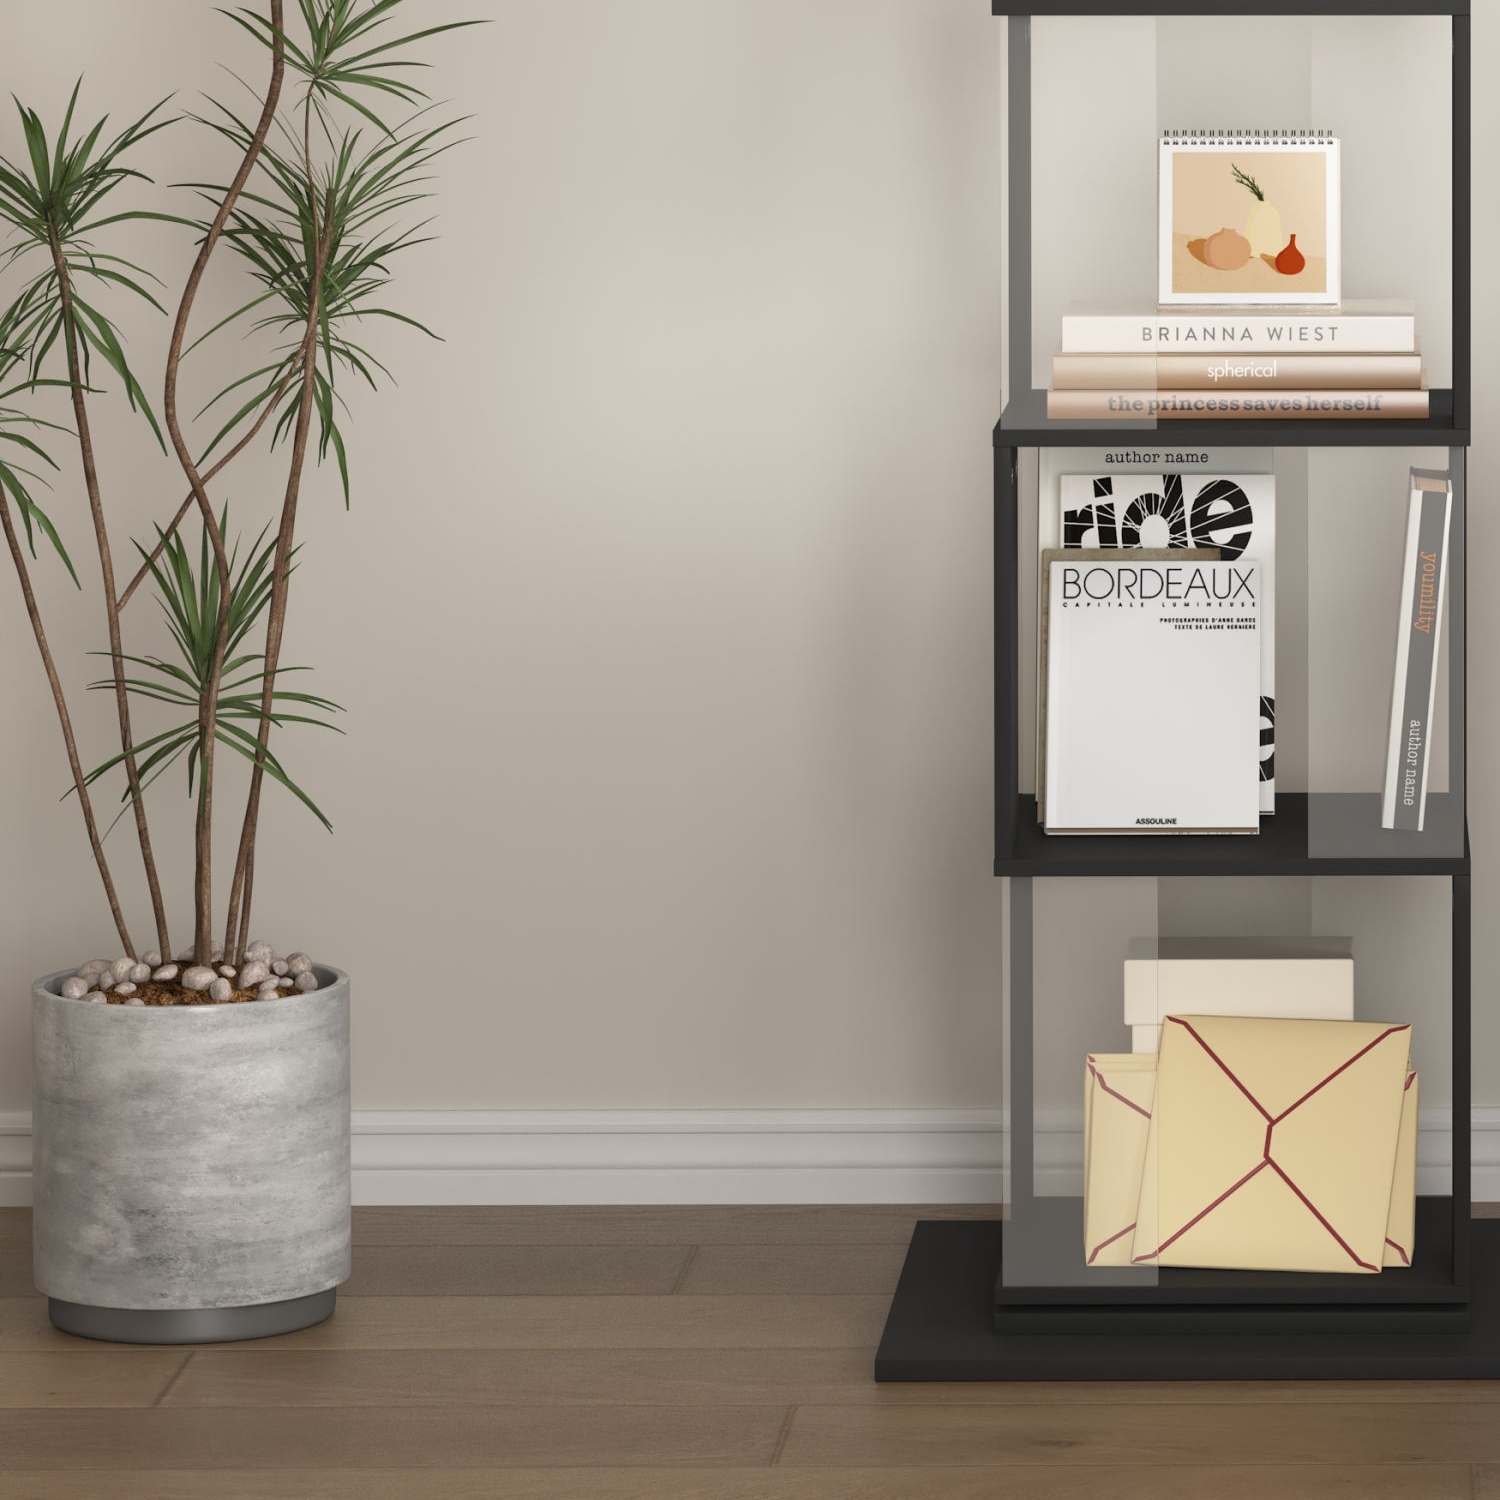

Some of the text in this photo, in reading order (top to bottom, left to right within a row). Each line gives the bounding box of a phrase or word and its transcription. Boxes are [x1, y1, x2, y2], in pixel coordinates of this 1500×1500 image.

[1141, 326, 1339, 341] BRIANNA WIEST
[1207, 359, 1278, 382] spherical
[1107, 394, 1384, 416] the princess saves herself
[1105, 450, 1209, 464] author name
[1064, 474, 1254, 561] ride
[1063, 567, 1255, 600] BORDEAUX
[1414, 551, 1437, 635] youmility
[1403, 719, 1421, 806] author name
